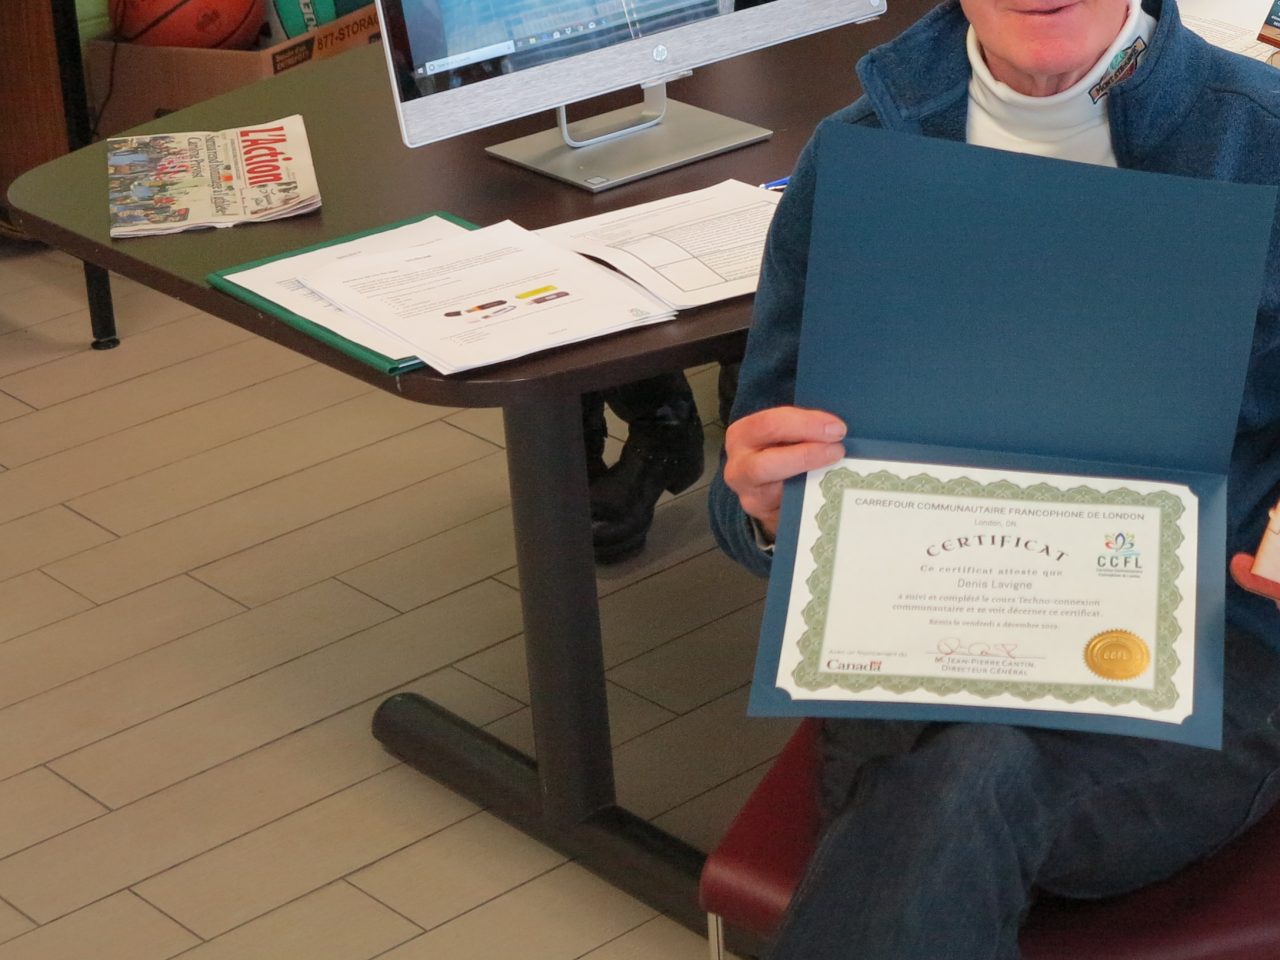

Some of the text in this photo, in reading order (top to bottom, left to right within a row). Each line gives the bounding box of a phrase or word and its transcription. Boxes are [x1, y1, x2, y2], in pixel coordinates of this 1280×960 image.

[240, 126, 293, 186] L'Action
[855, 497, 1145, 521] CARREFOUR COMMUNAUTAIRE FRANCOPHONE DE LONDON
[926, 534, 1069, 561] CERTIFICAT
[1098, 555, 1143, 569] CCFL
[920, 565, 934, 573] Ce
[939, 565, 993, 575] certificat
[1043, 570, 1063, 578] que
[958, 578, 1033, 591] Denis Lavigne
[892, 604, 965, 613] communautaire
[827, 658, 883, 672] Canada
